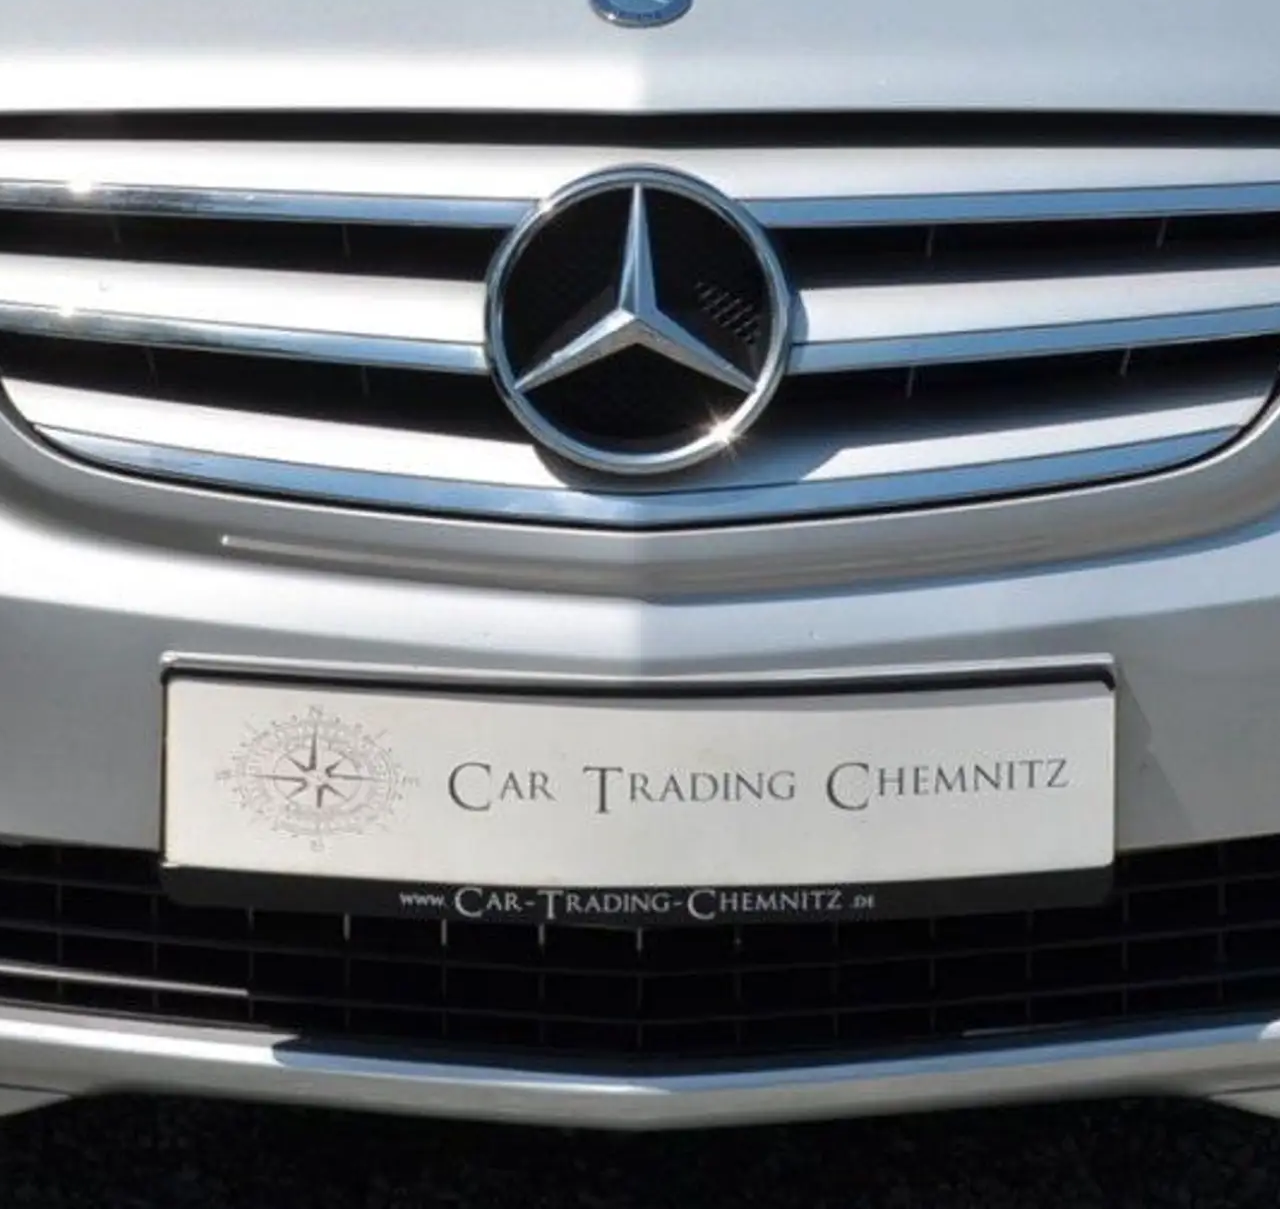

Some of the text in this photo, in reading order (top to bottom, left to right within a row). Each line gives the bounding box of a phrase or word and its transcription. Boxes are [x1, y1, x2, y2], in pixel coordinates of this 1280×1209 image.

[448, 762, 556, 812] CAR
[582, 765, 796, 814] TRADING
[826, 758, 1069, 811] CHEMNITZ
